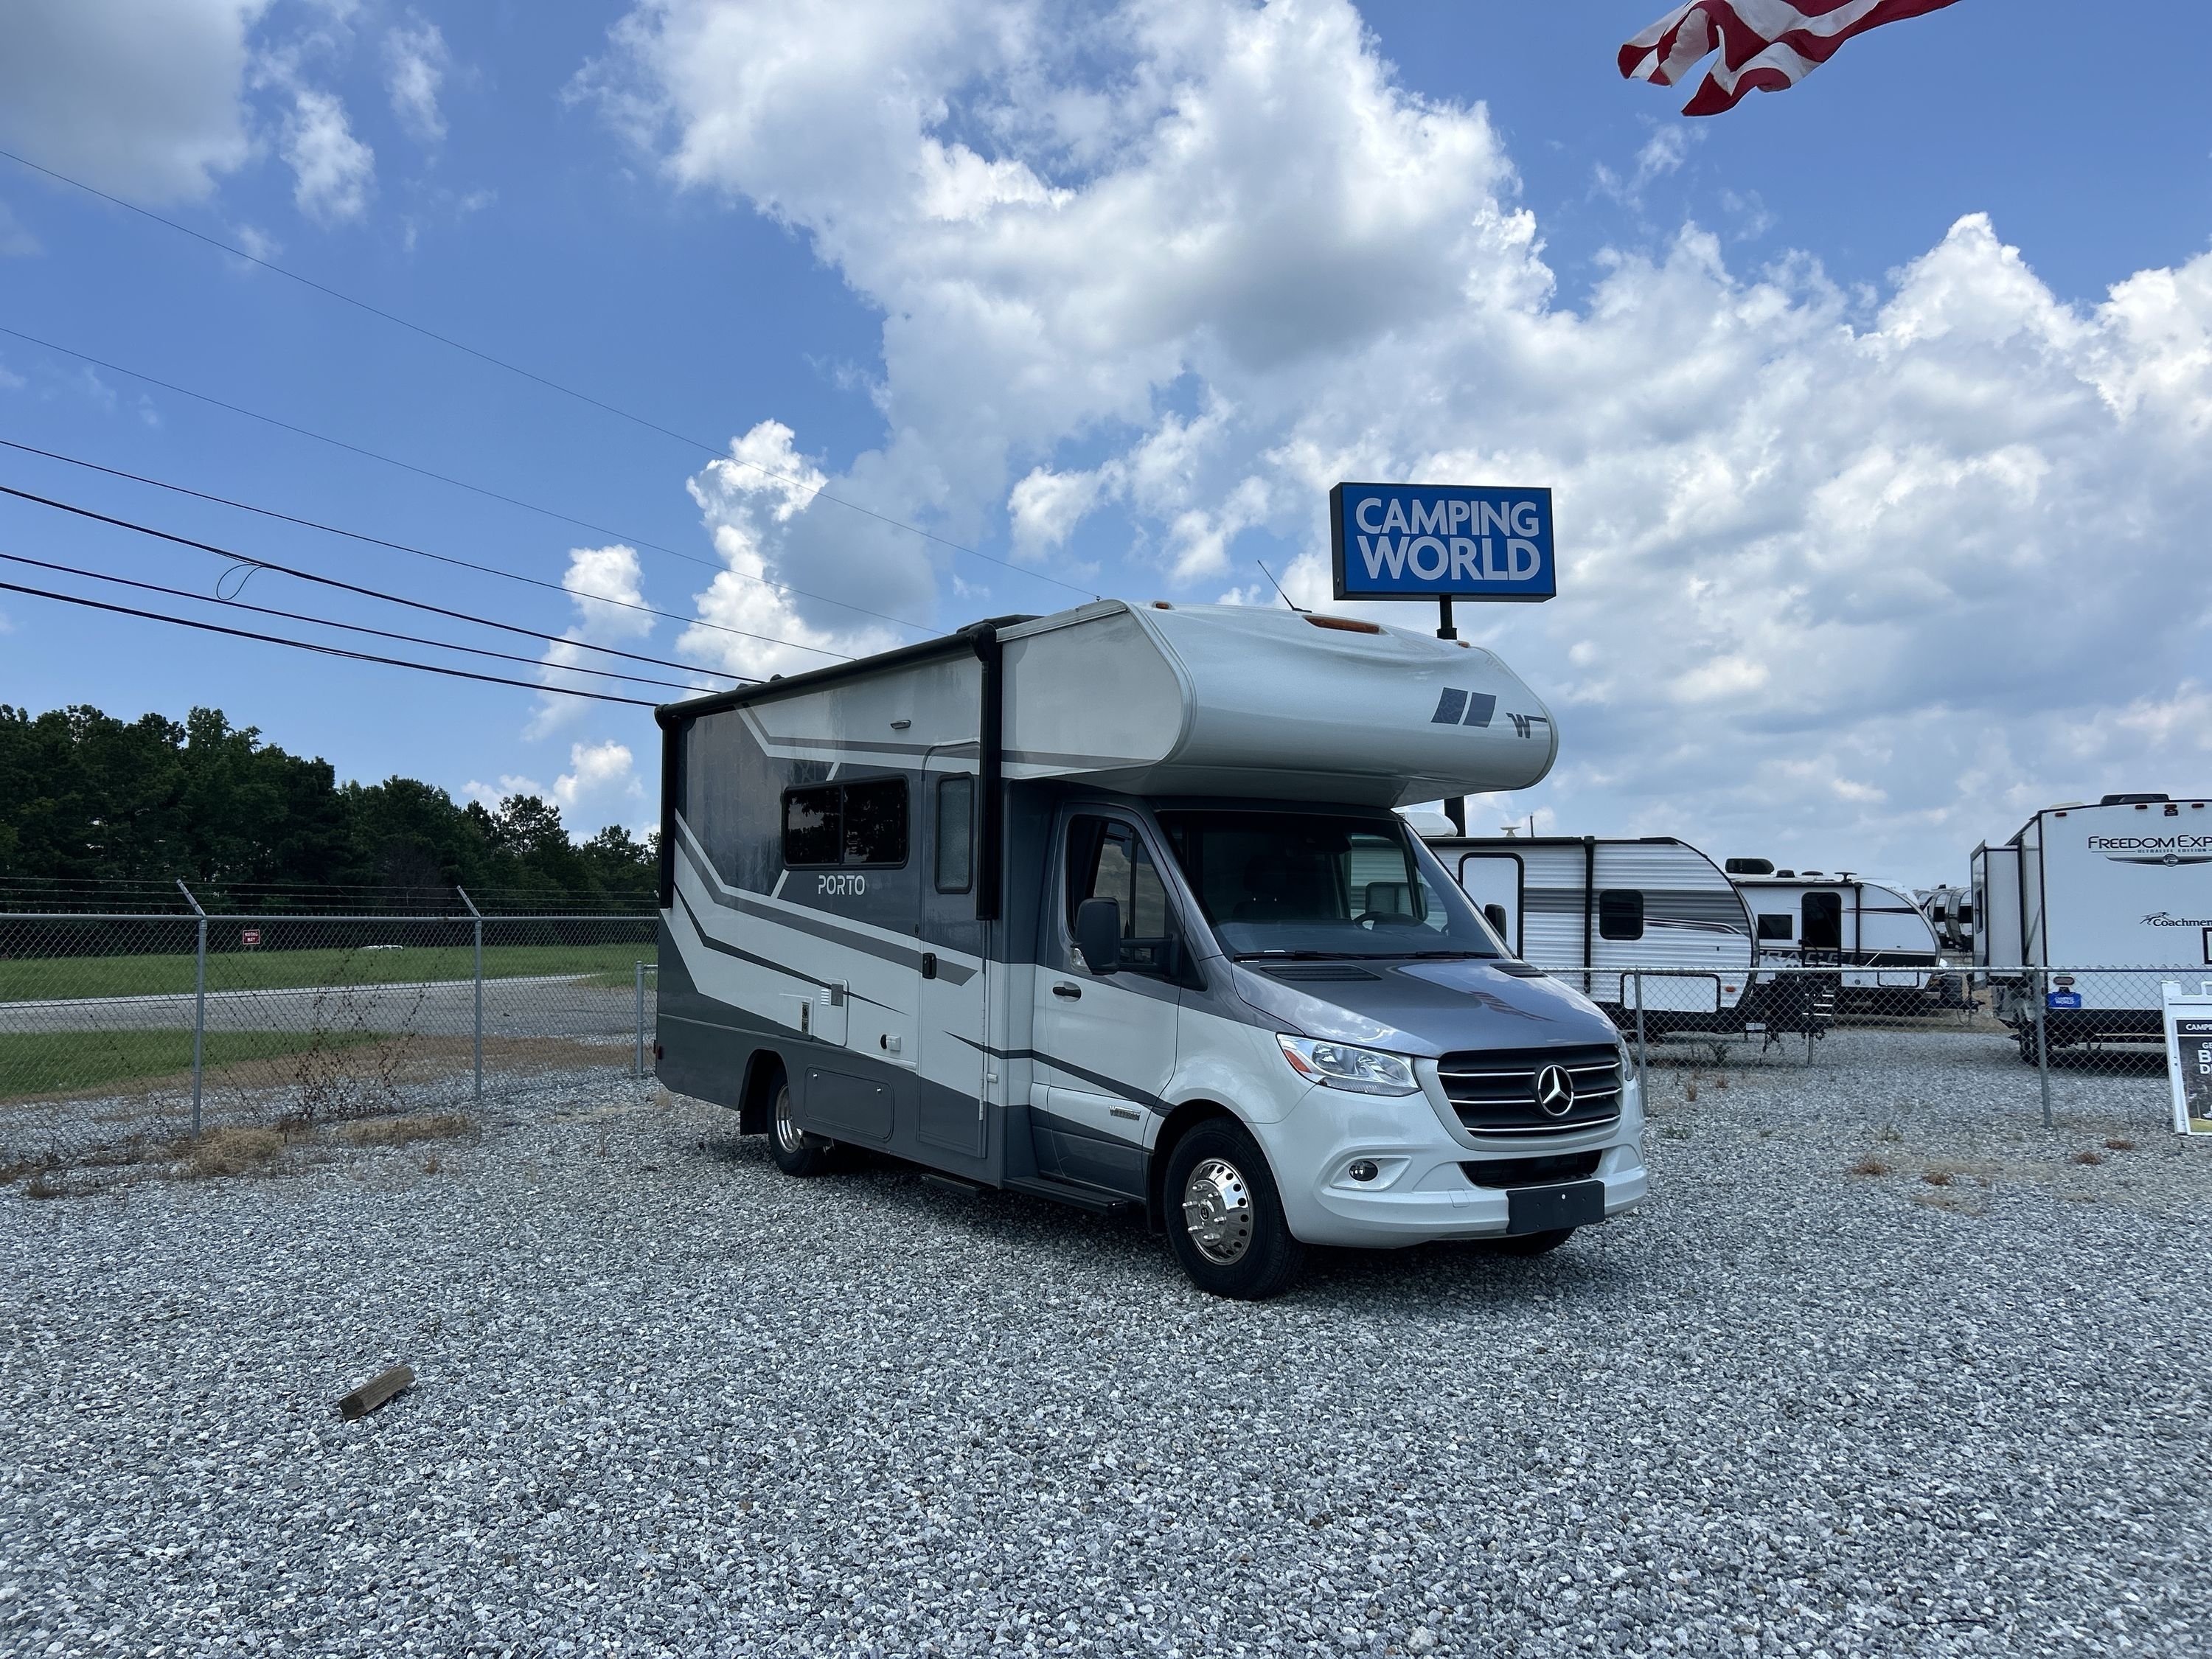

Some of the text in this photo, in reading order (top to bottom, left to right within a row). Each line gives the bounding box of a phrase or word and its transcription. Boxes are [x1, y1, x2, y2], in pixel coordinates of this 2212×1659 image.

[1355, 497, 1540, 538] CAMPING
[1357, 535, 1541, 581] WORLD
[2088, 835, 2175, 849] FREEDOM
[818, 874, 866, 895] PORTO
[1759, 950, 1868, 964] RACER
[2199, 1064, 2212, 1074] D
